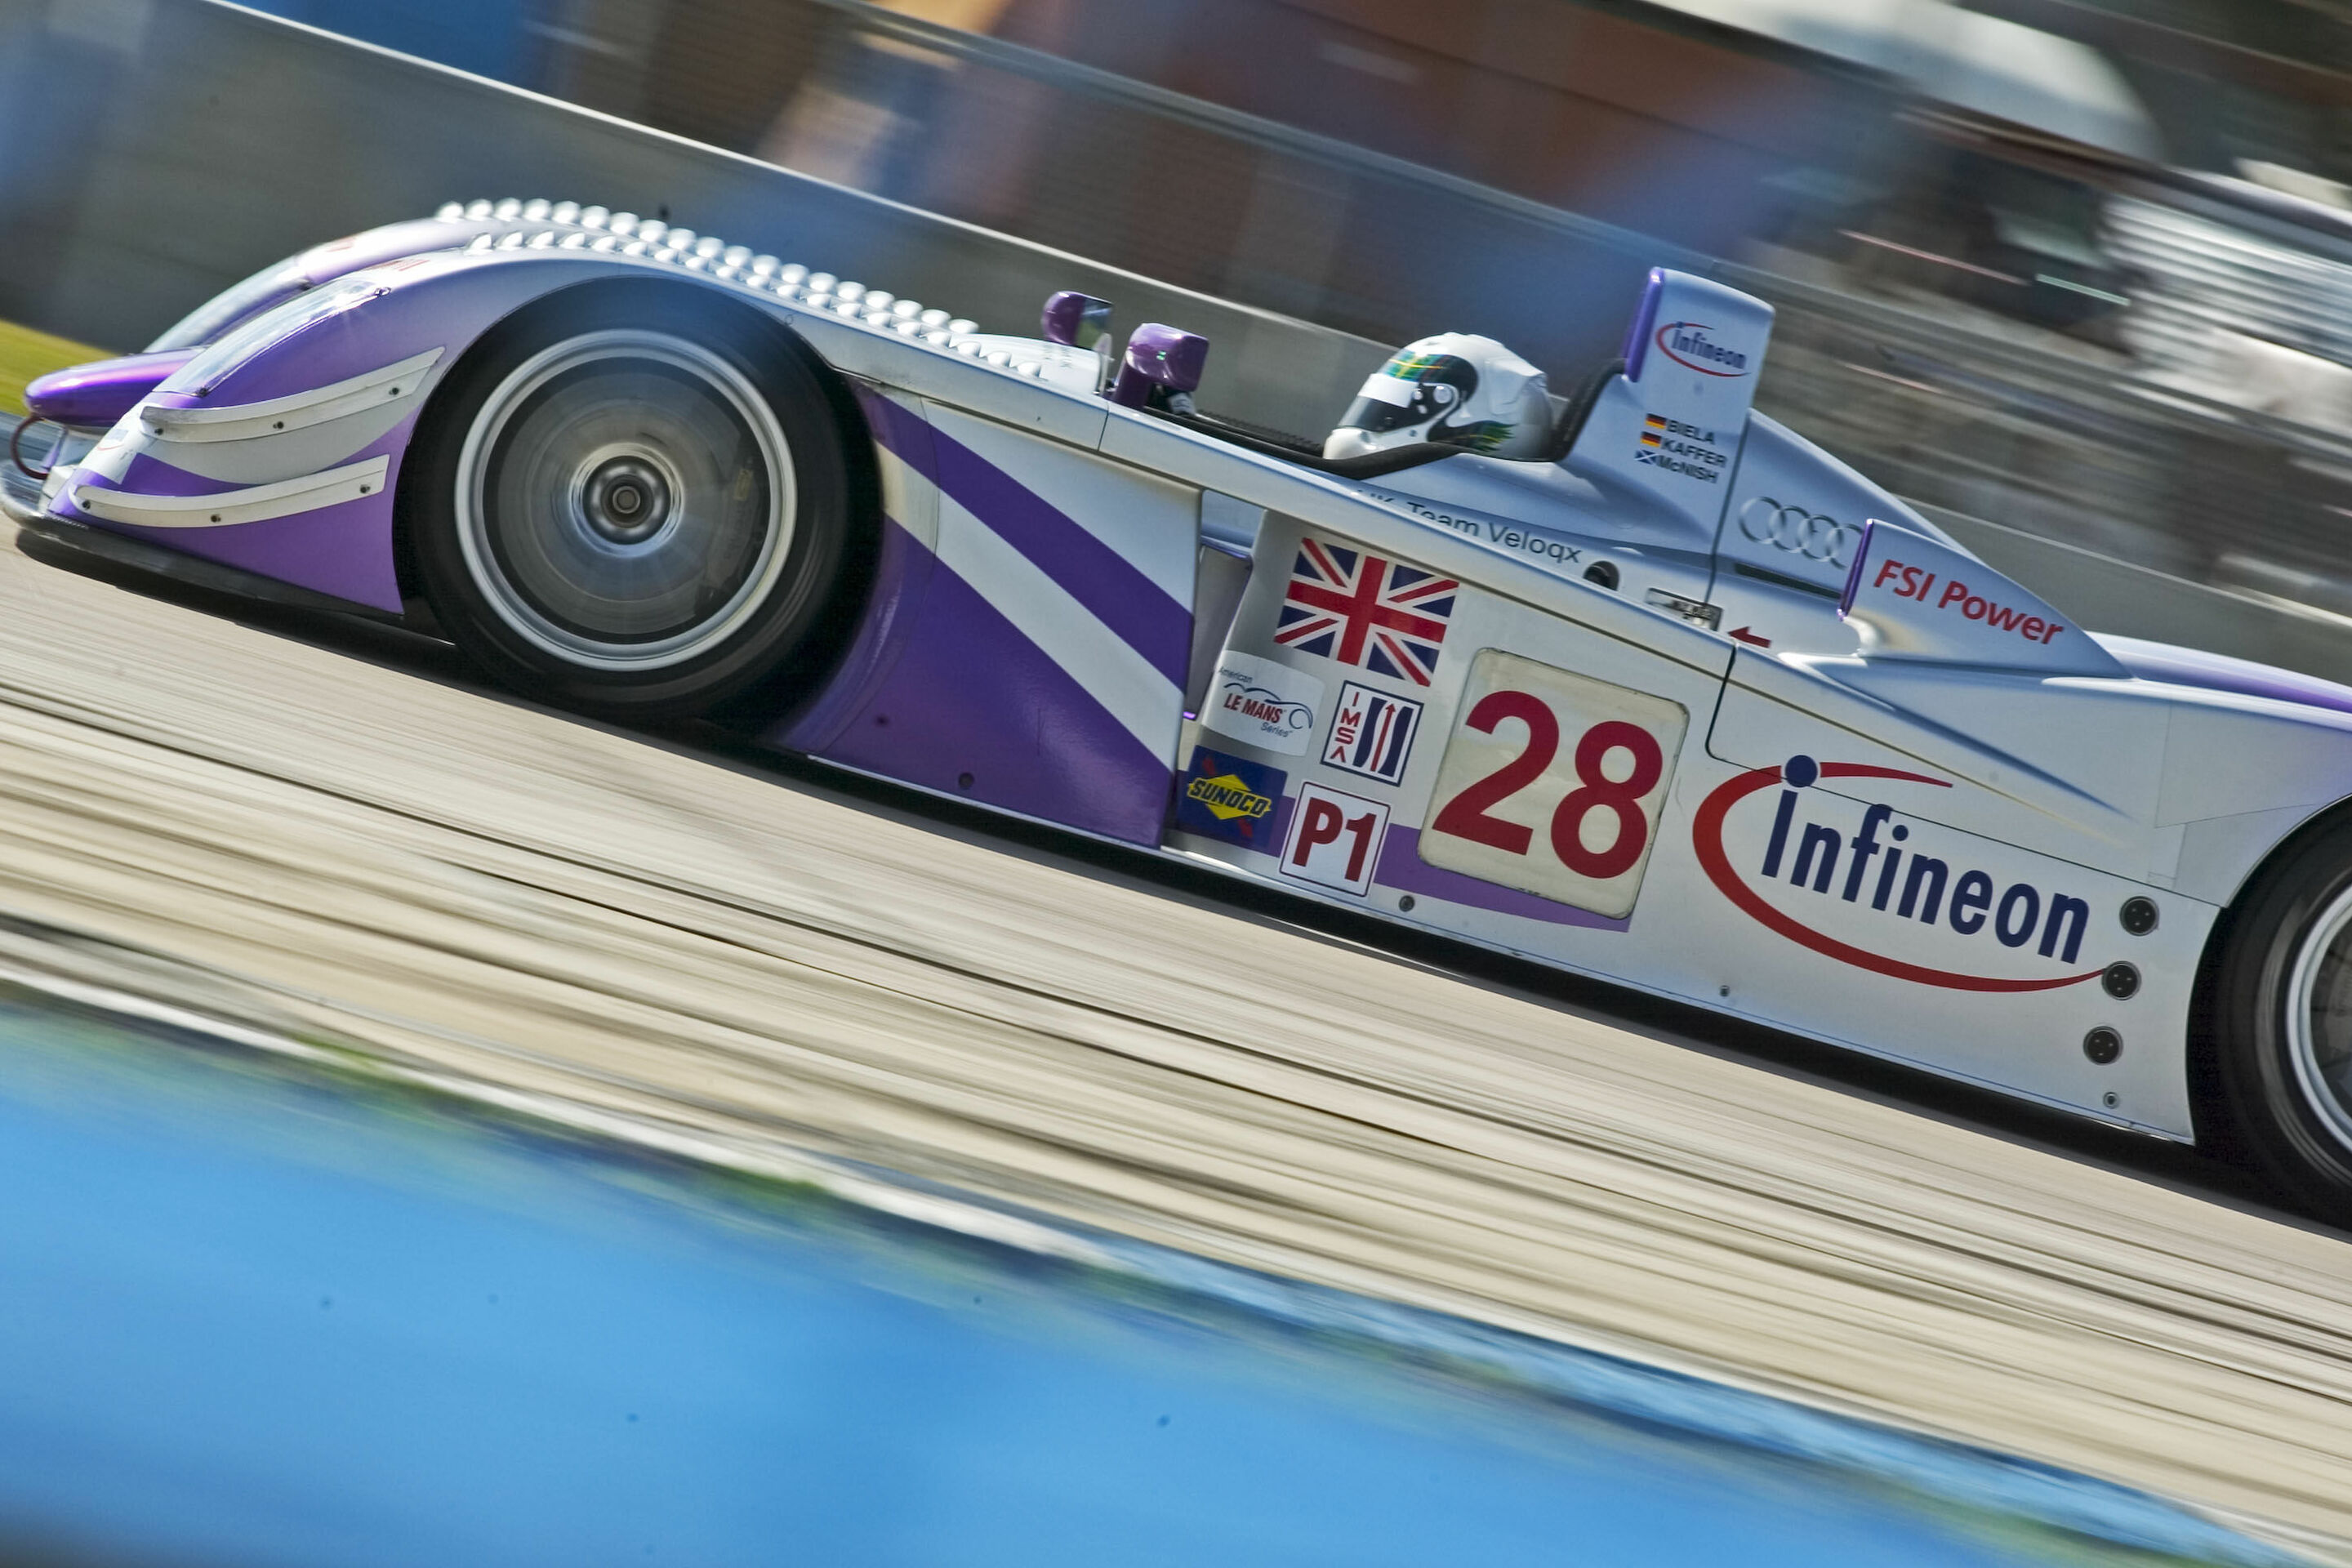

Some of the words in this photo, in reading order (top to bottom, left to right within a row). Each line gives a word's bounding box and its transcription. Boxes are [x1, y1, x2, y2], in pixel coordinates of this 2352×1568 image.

[1666, 419, 1715, 445] BIELA
[1657, 455, 1719, 483] McNISH
[1661, 437, 1728, 468] KAFFER
[1406, 501, 1480, 536] Team
[1488, 522, 1582, 564] Veloqx
[1873, 559, 1934, 603] FSI
[1938, 580, 2065, 645] Power
[1223, 693, 1242, 710] LE
[1242, 698, 1283, 724] MANS
[1260, 721, 1290, 737] Series
[1190, 779, 1269, 816] SUNOCO
[1432, 690, 1663, 879] 28
[1292, 796, 1377, 882] P1
